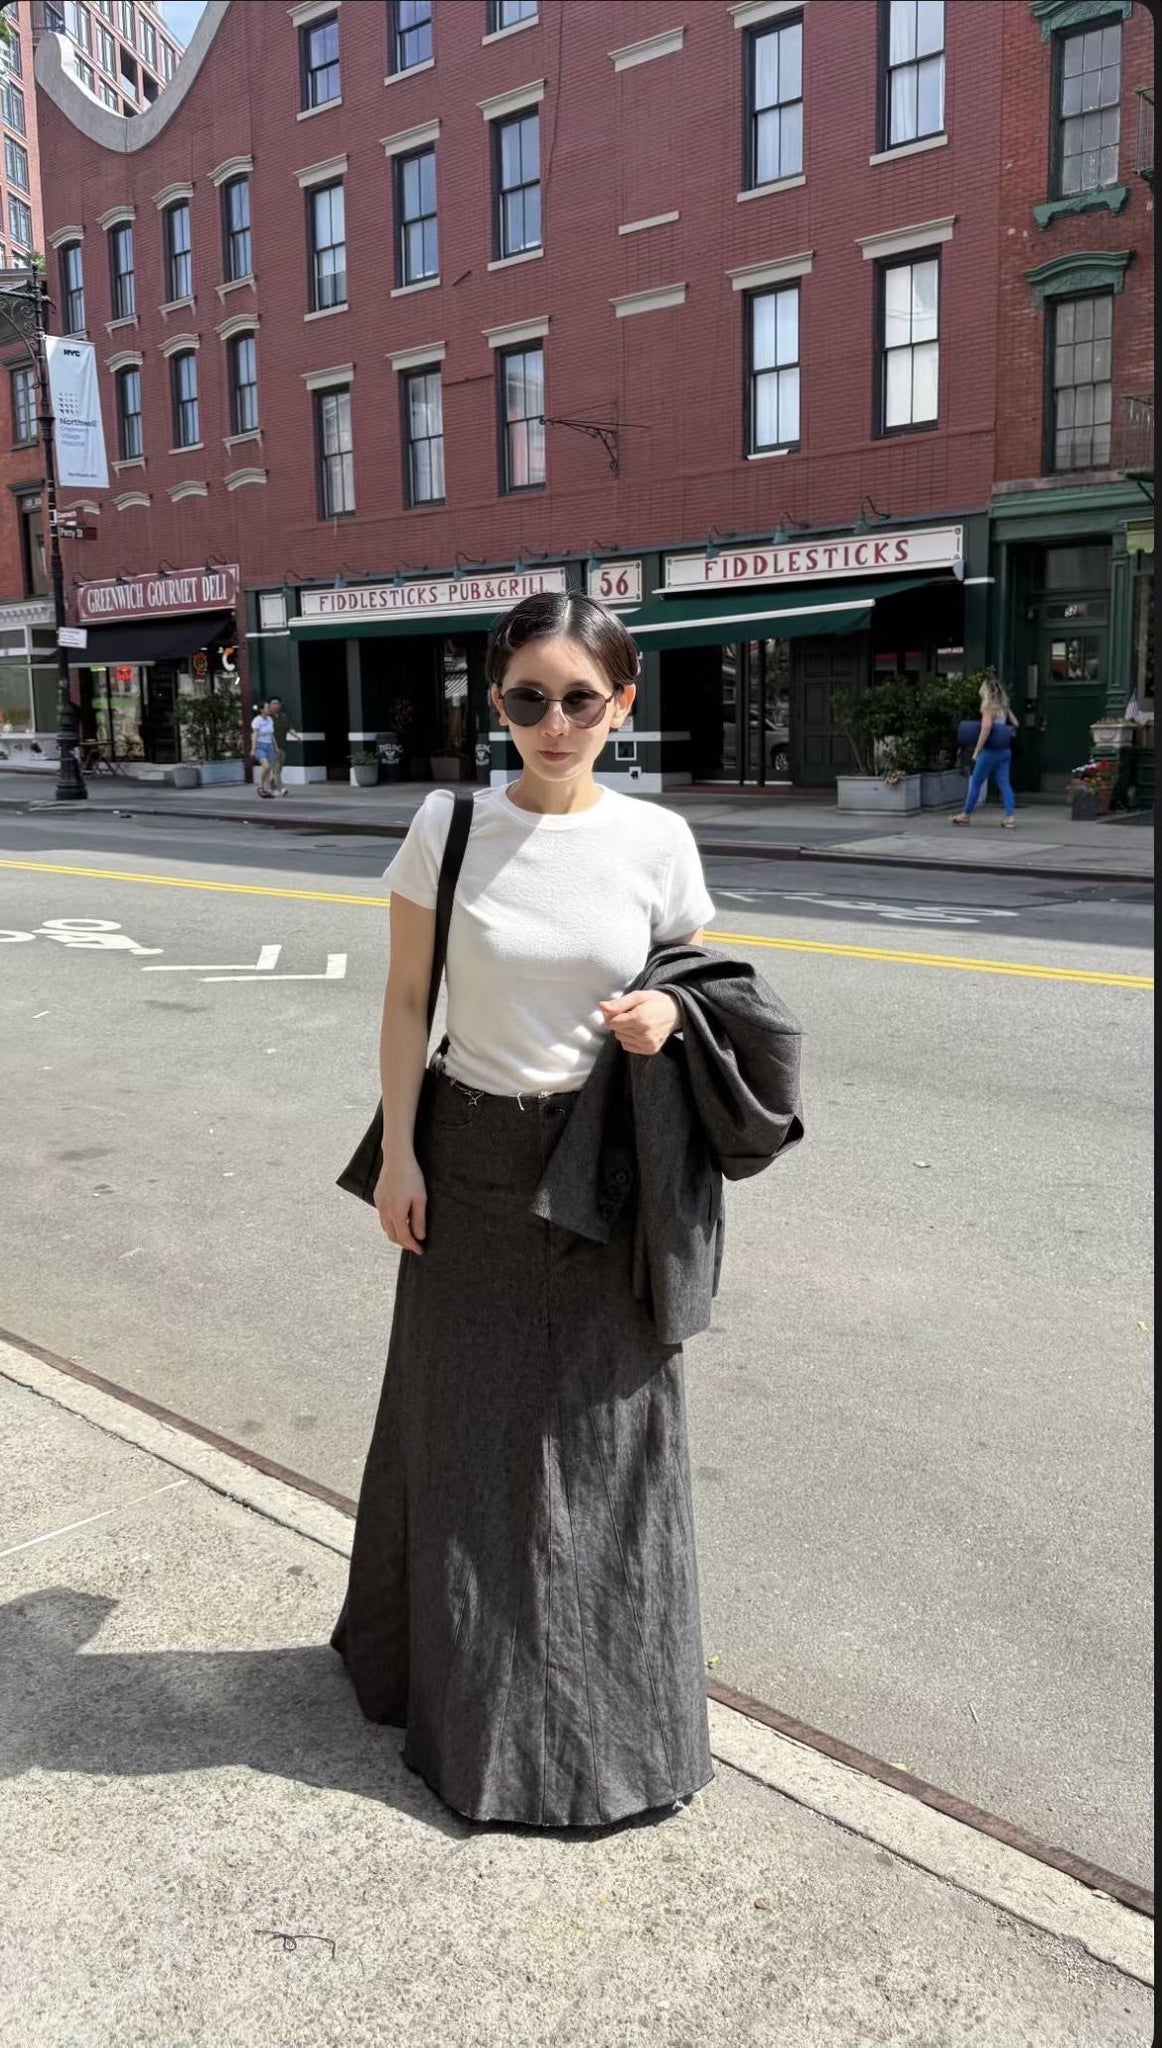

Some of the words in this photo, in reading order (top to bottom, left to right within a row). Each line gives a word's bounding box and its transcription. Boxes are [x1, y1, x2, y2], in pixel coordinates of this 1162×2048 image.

[63, 349, 81, 357] NYC
[704, 539, 910, 581] FIDDLESTICKS
[87, 583, 143, 613] GREENWICH
[147, 577, 198, 607] GOURMET
[202, 573, 227, 602] DELI
[600, 570, 629, 597] 56
[319, 586, 437, 611] FIDDLESTICKS
